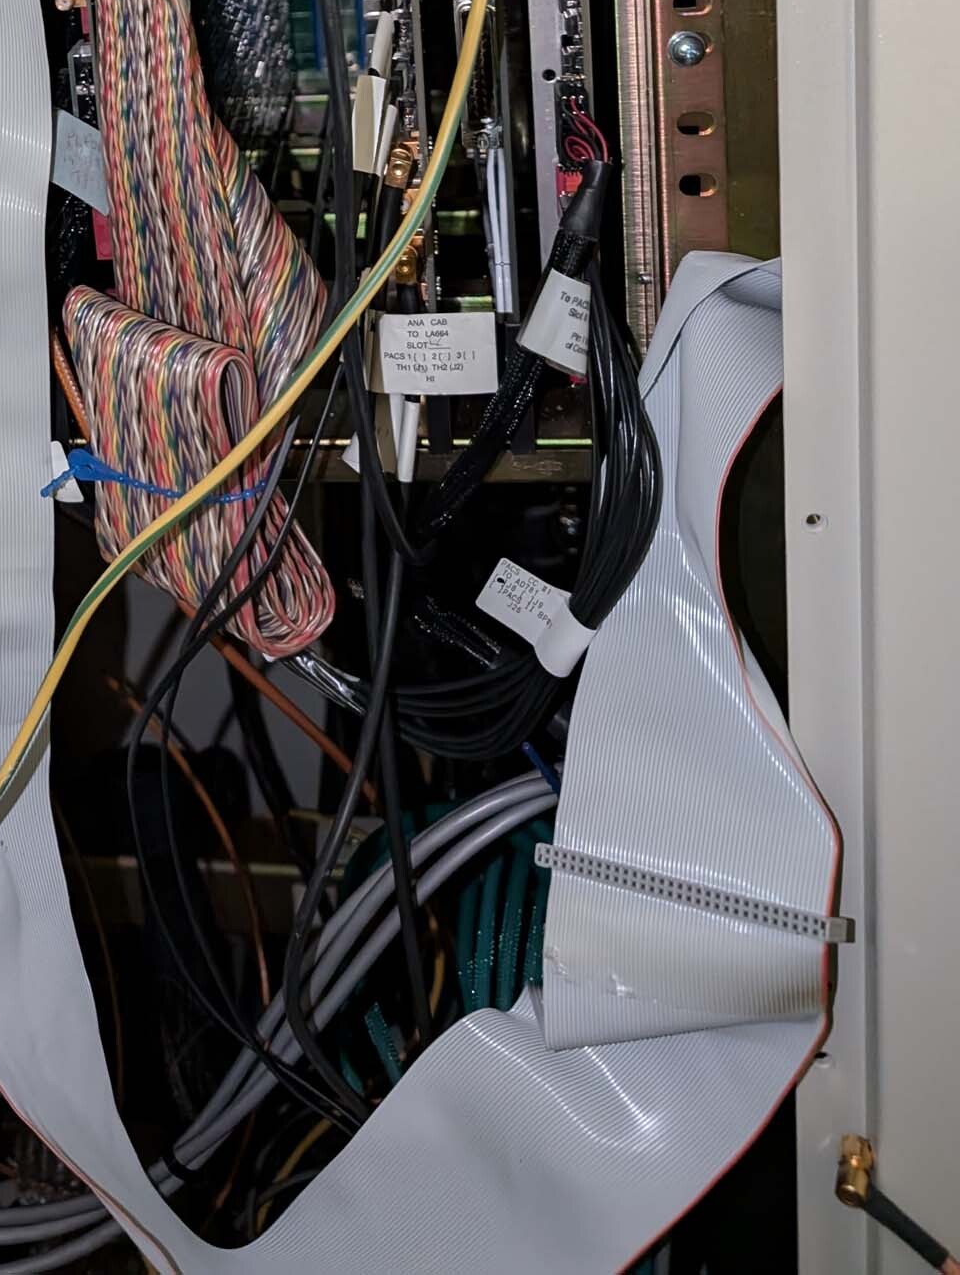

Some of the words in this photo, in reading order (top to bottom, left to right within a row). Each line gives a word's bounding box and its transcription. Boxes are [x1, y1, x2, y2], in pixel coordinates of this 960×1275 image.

[431, 318, 447, 326] CAB
[407, 341, 427, 349] SLOT
[384, 351, 405, 360] PACS
[501, 559, 521, 576] PACS
